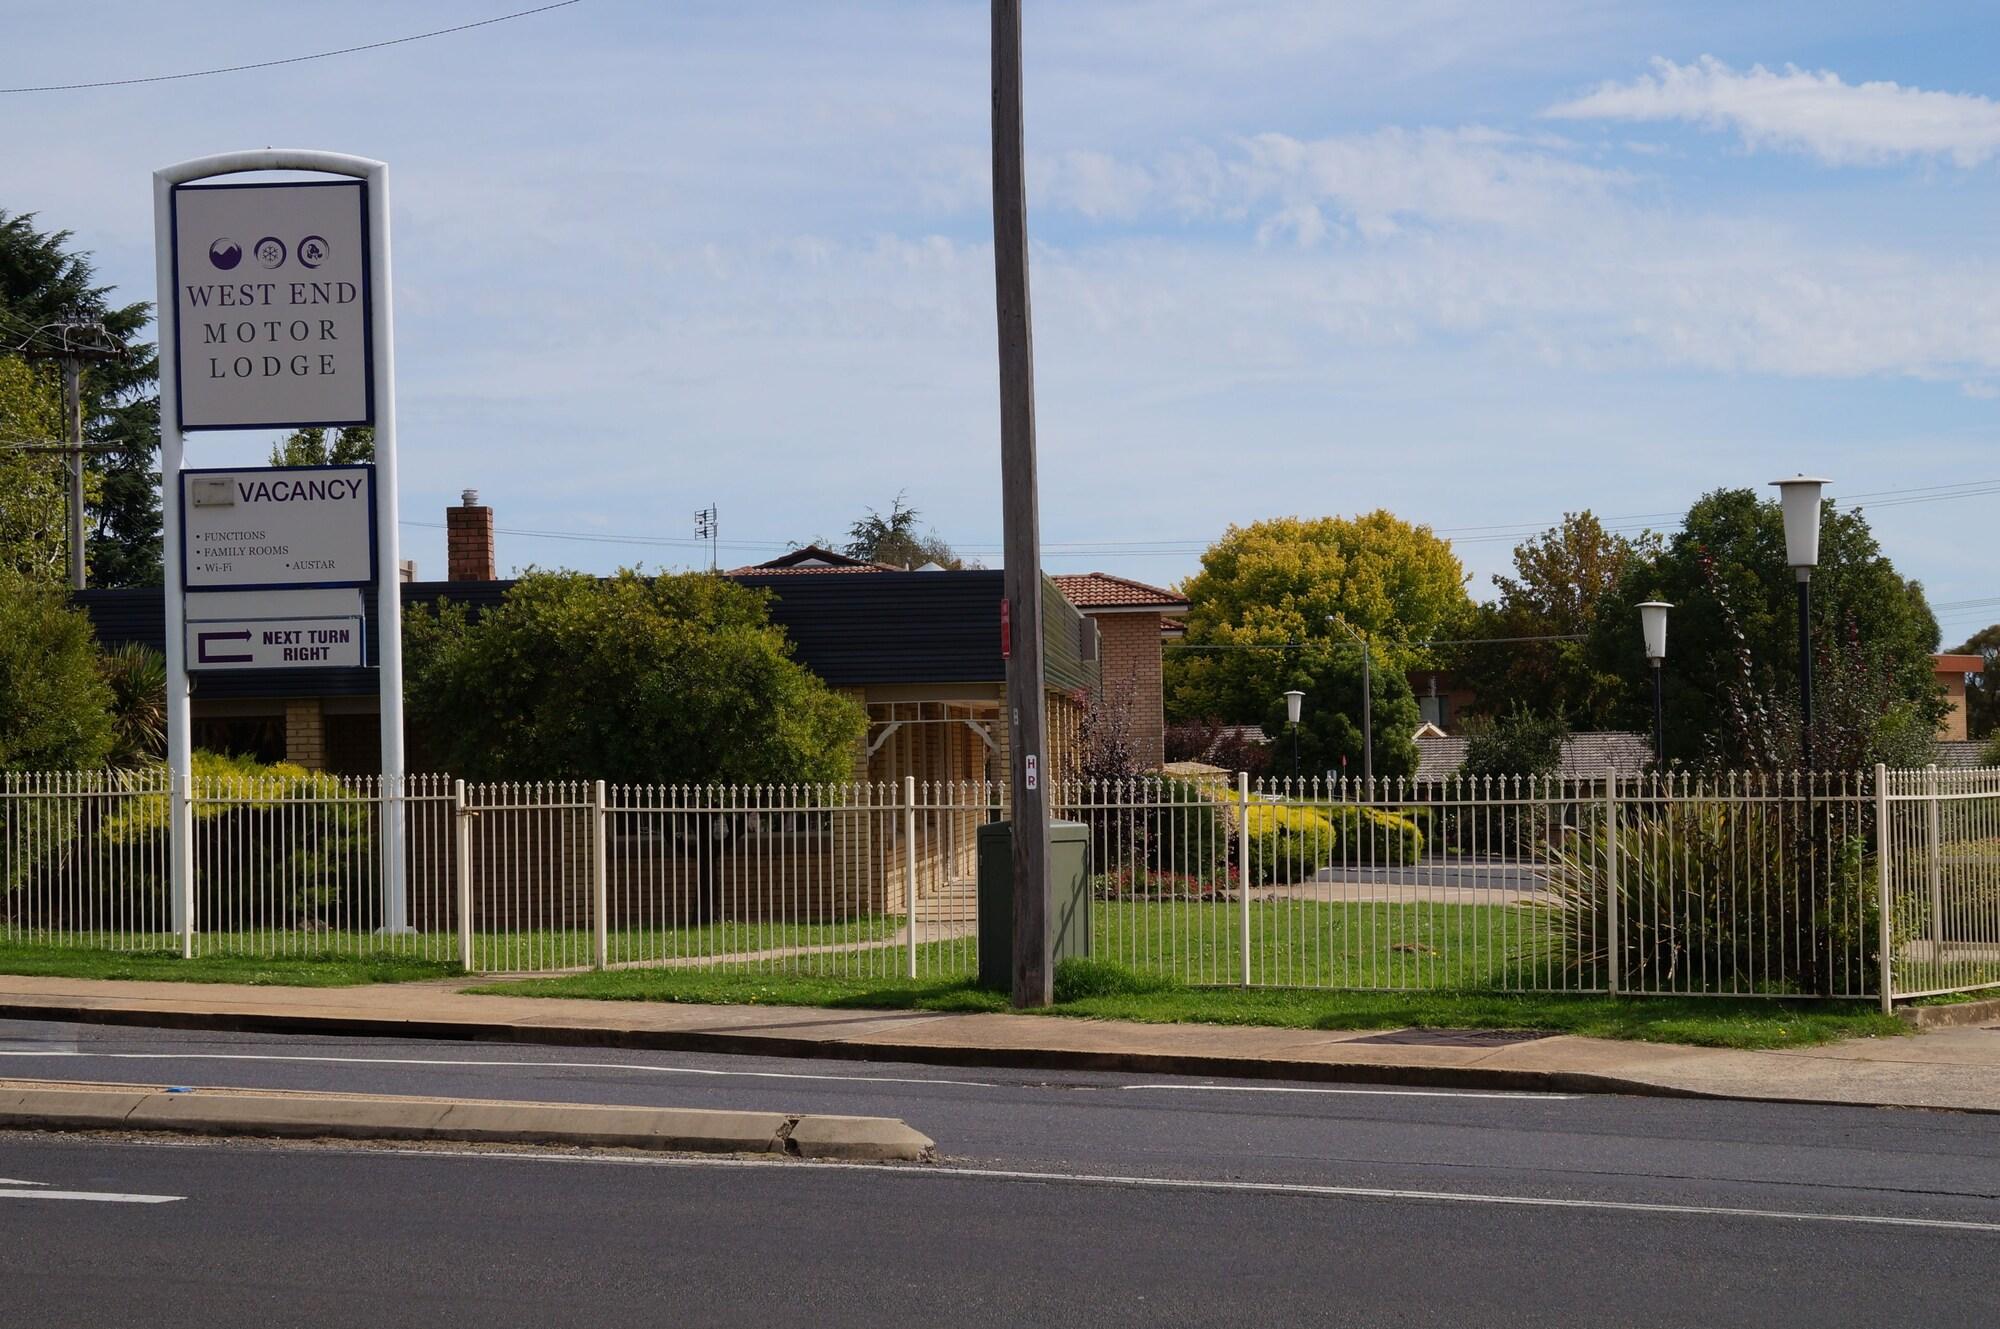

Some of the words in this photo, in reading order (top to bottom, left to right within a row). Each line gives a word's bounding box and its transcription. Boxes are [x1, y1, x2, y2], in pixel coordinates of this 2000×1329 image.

[186, 284, 276, 307] WEST
[289, 282, 357, 305] END
[203, 320, 338, 344] MOTOR
[210, 354, 336, 378] LODGE
[238, 479, 362, 502] VACANCY
[204, 531, 266, 541] FUNCTIONS
[204, 547, 247, 557] FAMILY
[248, 546, 289, 556] ROOMS
[204, 563, 232, 572] Wi-Fi
[292, 560, 336, 570] AUSTAR
[263, 631, 302, 645] NEXT
[308, 630, 350, 643] TURN
[283, 647, 330, 661] RIGHT
